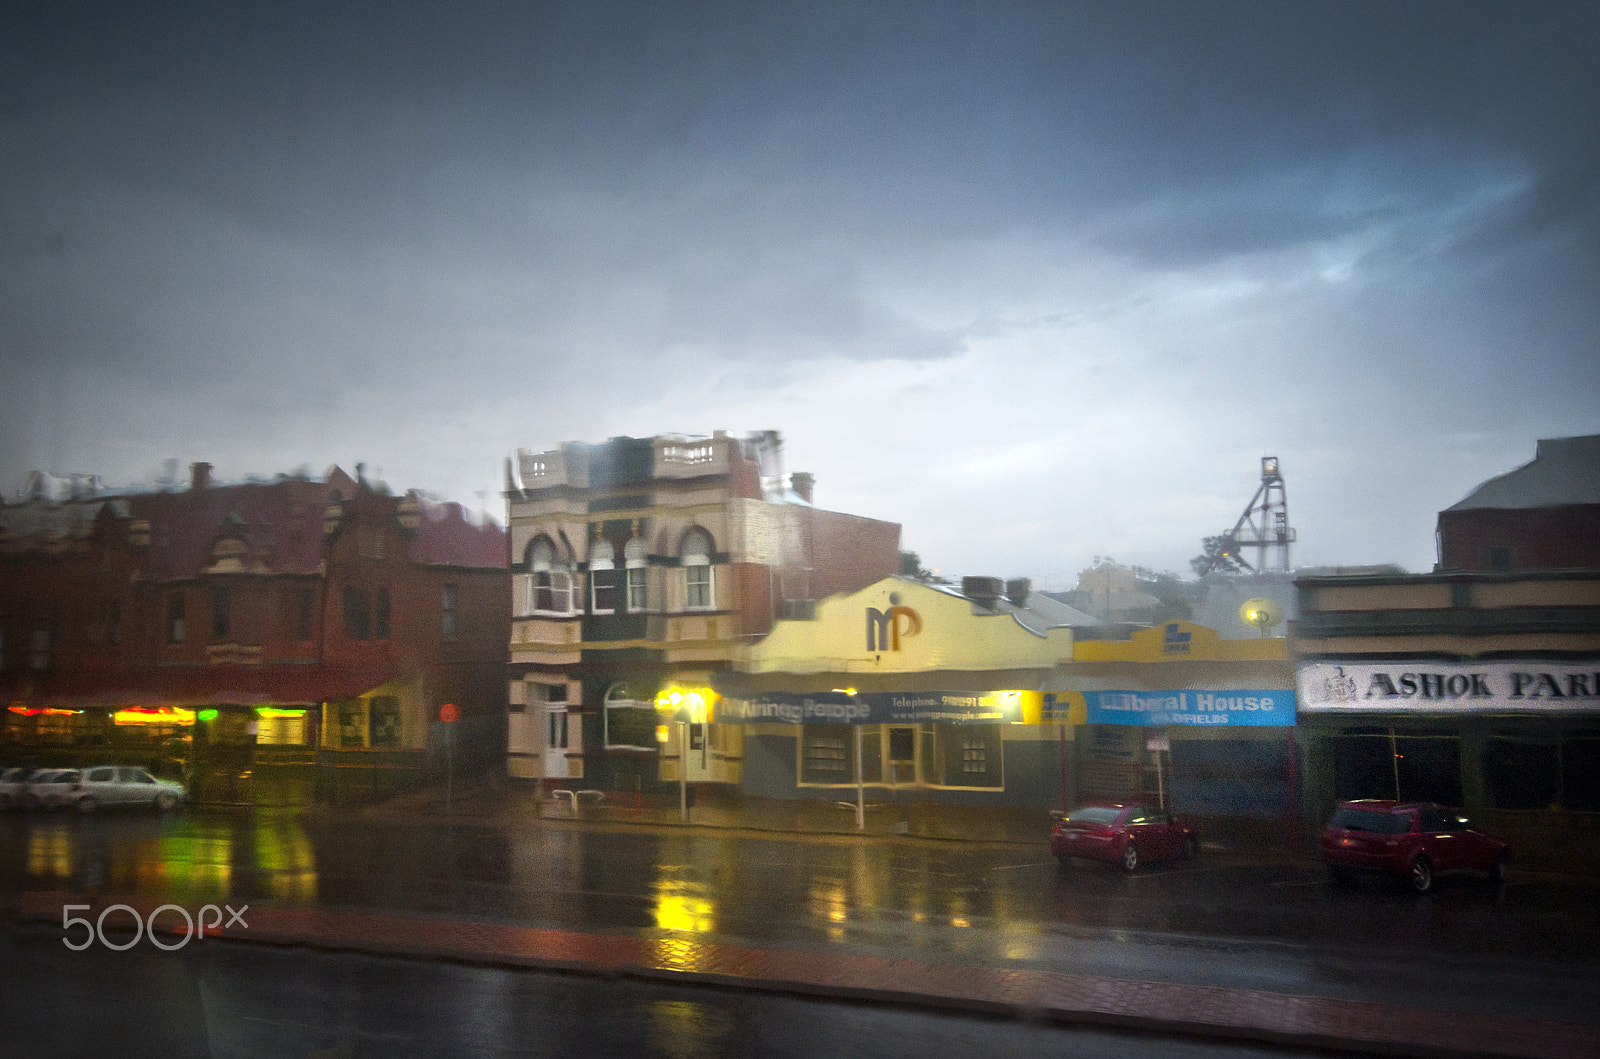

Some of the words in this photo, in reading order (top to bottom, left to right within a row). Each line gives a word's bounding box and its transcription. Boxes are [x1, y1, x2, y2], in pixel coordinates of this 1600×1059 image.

[1365, 673, 1495, 700] ASHOK
[1099, 692, 1187, 712] Liberal
[1197, 694, 1275, 711] House
